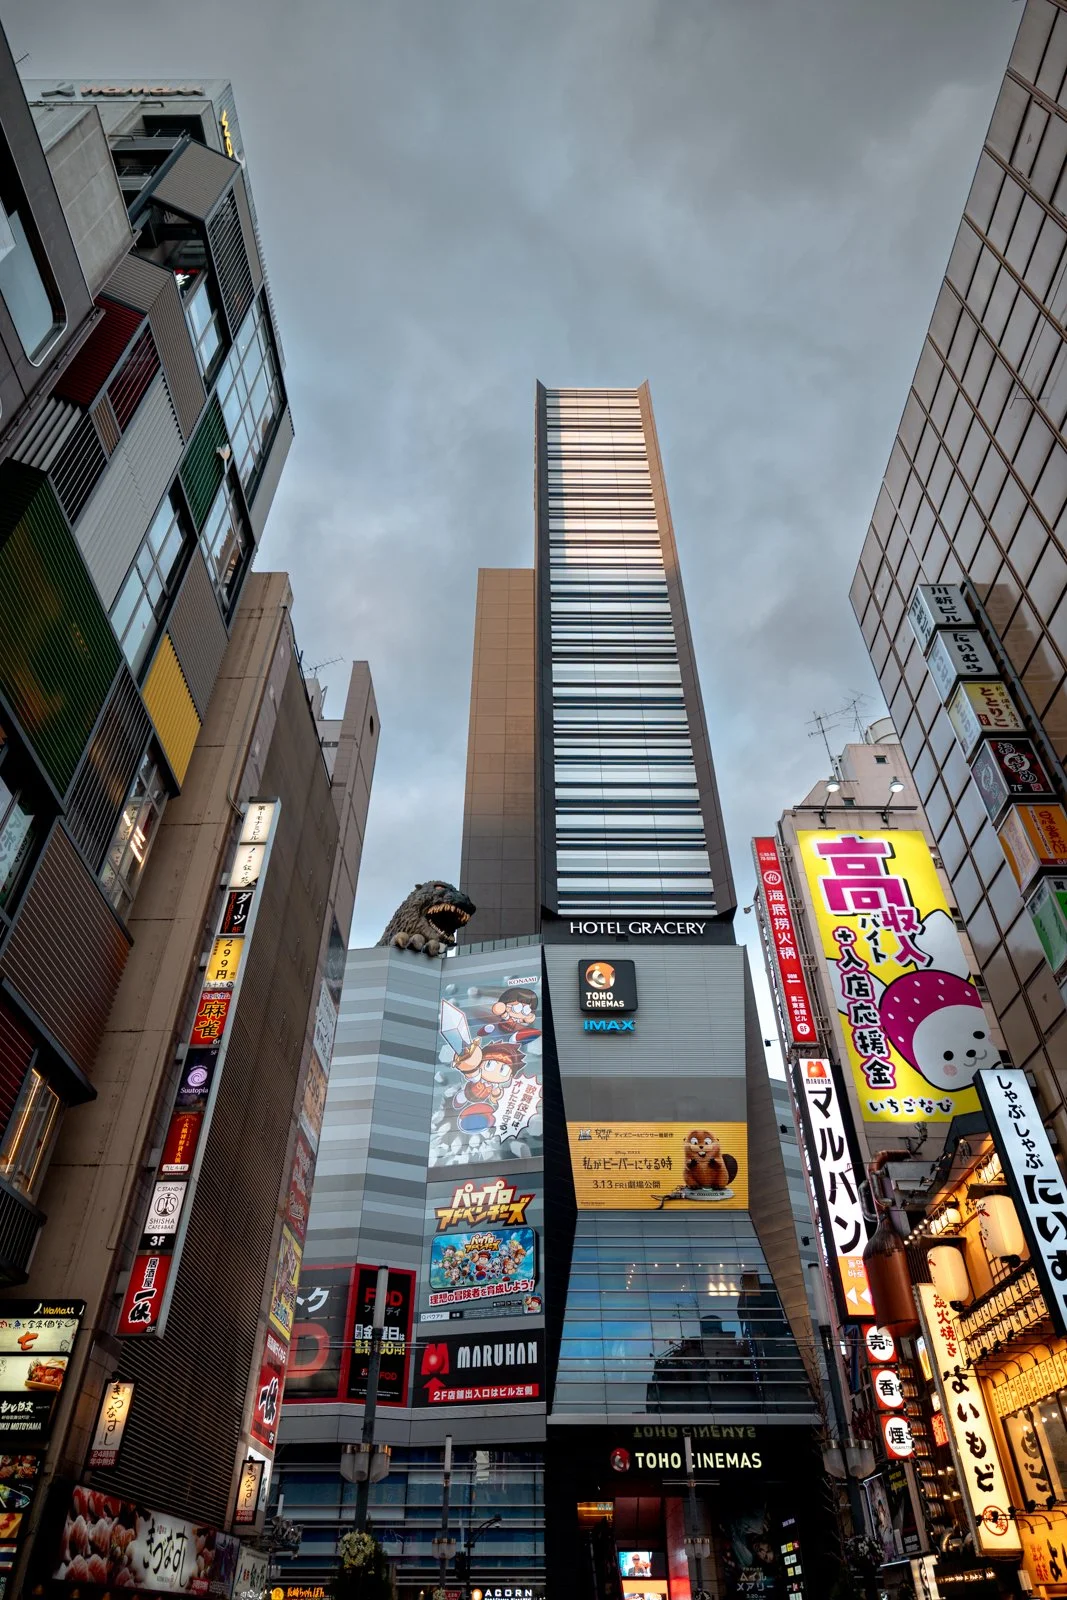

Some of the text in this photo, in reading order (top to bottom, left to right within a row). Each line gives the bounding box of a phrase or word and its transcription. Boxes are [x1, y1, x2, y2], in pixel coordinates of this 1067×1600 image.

[930, 586, 962, 623] 川新ビル
[952, 632, 983, 673] にいむら
[979, 686, 1009, 728] ととりこ
[1010, 784, 1023, 792] 7F
[234, 891, 252, 925] ダーツ
[569, 921, 707, 935] HOTEL GRACERY
[859, 912, 888, 964] バイト
[215, 939, 233, 979] 299円
[508, 977, 538, 986] KONAMI
[586, 991, 614, 1000] TOHO
[586, 1000, 625, 1008] CINEMAS
[195, 1000, 227, 1039] 麻雀
[583, 1019, 635, 1031] IMAX
[180, 1086, 209, 1095] Suutopia
[868, 1097, 953, 1115] いちごなび
[996, 1075, 1044, 1170] しゃぶしゃぶ
[582, 1156, 673, 1170] 私がビーバーになる時
[807, 1086, 862, 1256] マルハン
[593, 1179, 613, 1189] 3.13
[451, 1179, 517, 1210] パワプロ
[149, 1217, 176, 1225] SHISHA
[149, 1235, 166, 1247] 3F
[365, 1287, 403, 1307] FD
[429, 1279, 535, 1306] 理想の冒険者を育成しよう!
[128, 1288, 157, 1324] 一休
[869, 1334, 886, 1351] 売
[457, 1341, 538, 1369] MARUHAN
[433, 1388, 533, 1402] 2F店舗出入口はビル左側
[879, 1380, 895, 1397] 香
[10, 1422, 42, 1430] MOTOYAMA
[889, 1427, 906, 1445] 煙
[635, 1452, 682, 1469] TOHO
[484, 1588, 533, 1597] ACORN
